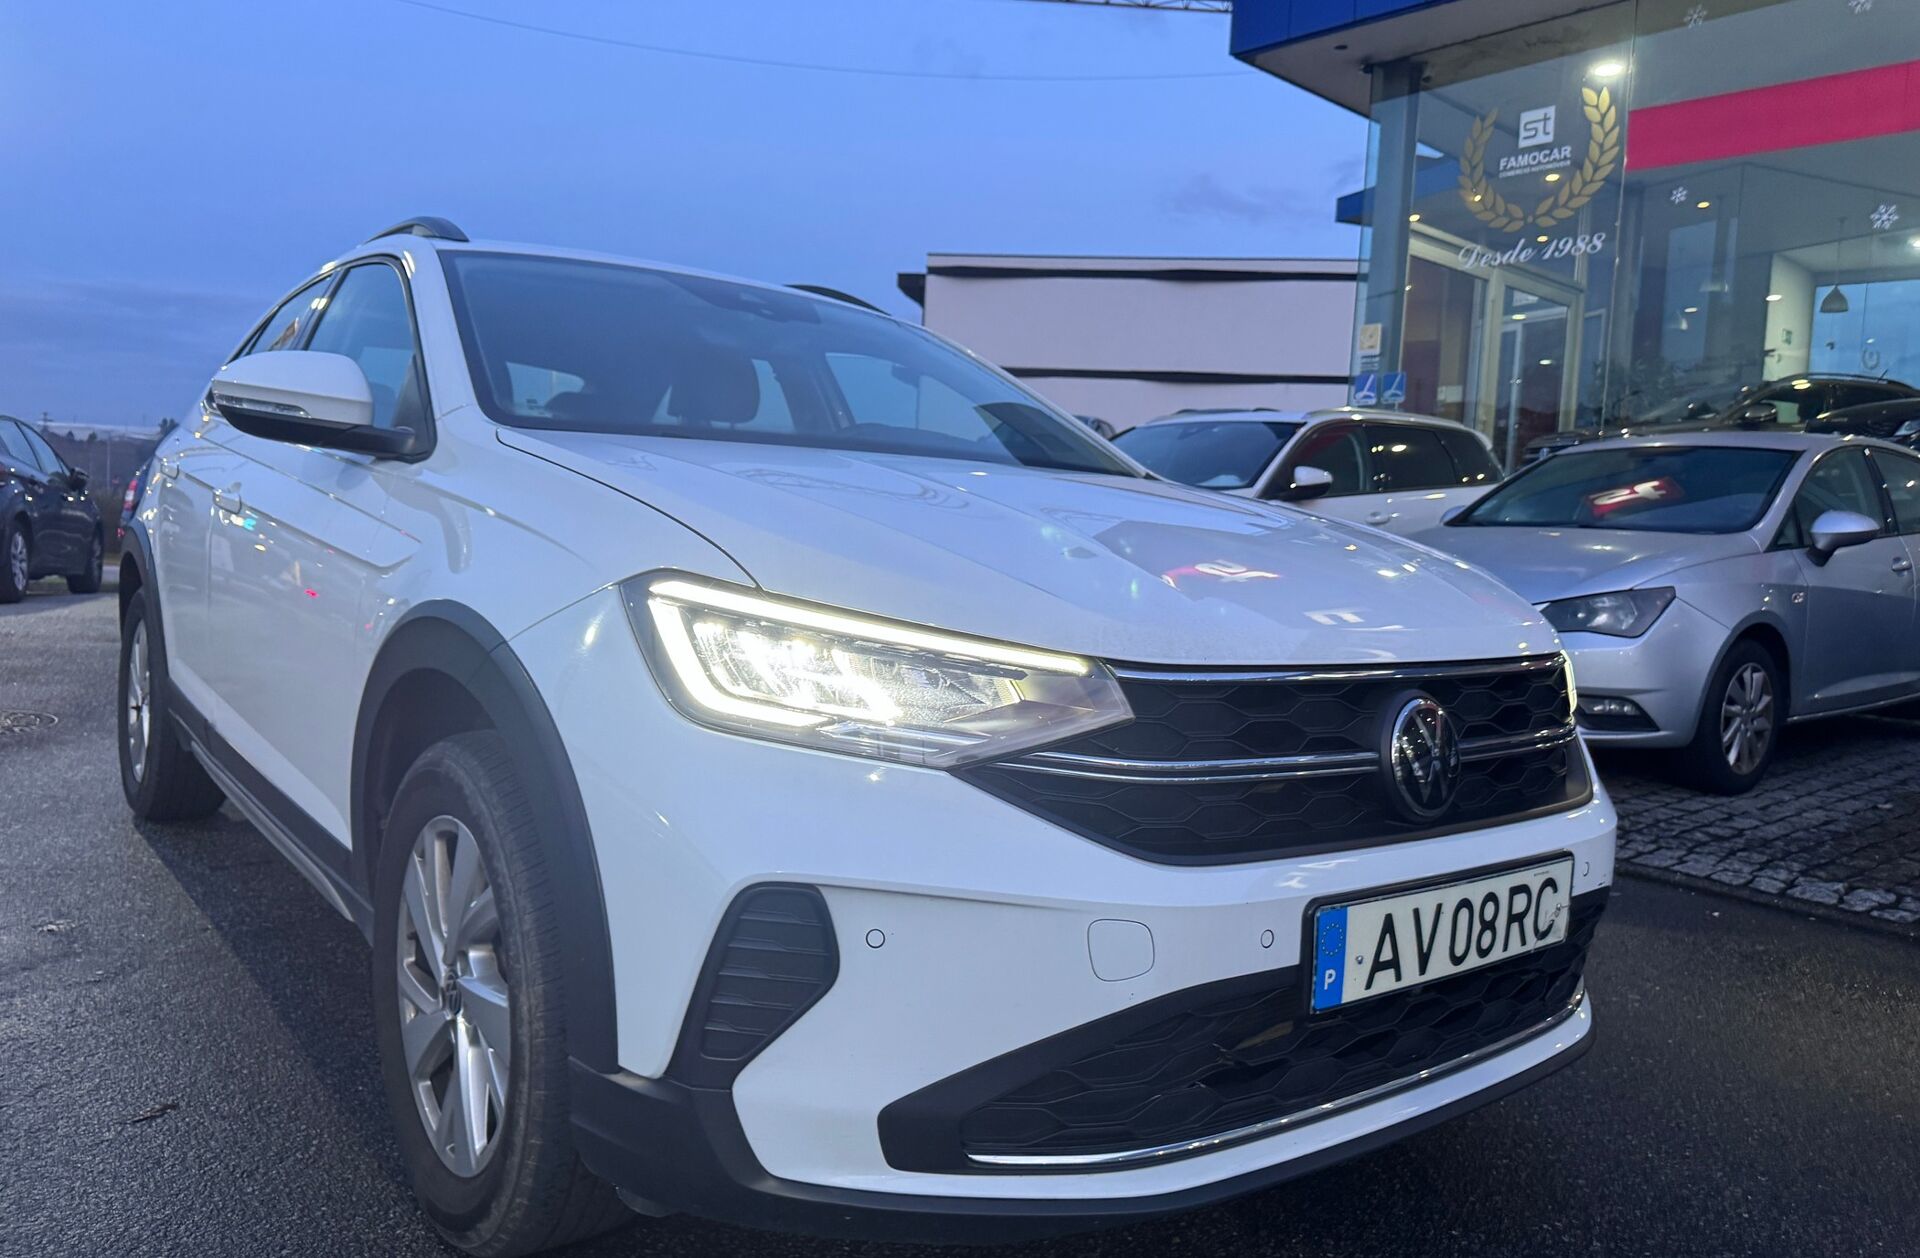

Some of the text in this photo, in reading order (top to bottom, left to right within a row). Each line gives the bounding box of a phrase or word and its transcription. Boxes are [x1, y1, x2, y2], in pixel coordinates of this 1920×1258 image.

[1499, 145, 1572, 171] FAMOCAR
[1458, 232, 1606, 268] Desde 1988
[1364, 877, 1558, 990] AV08RC
[1324, 969, 1336, 990] P
